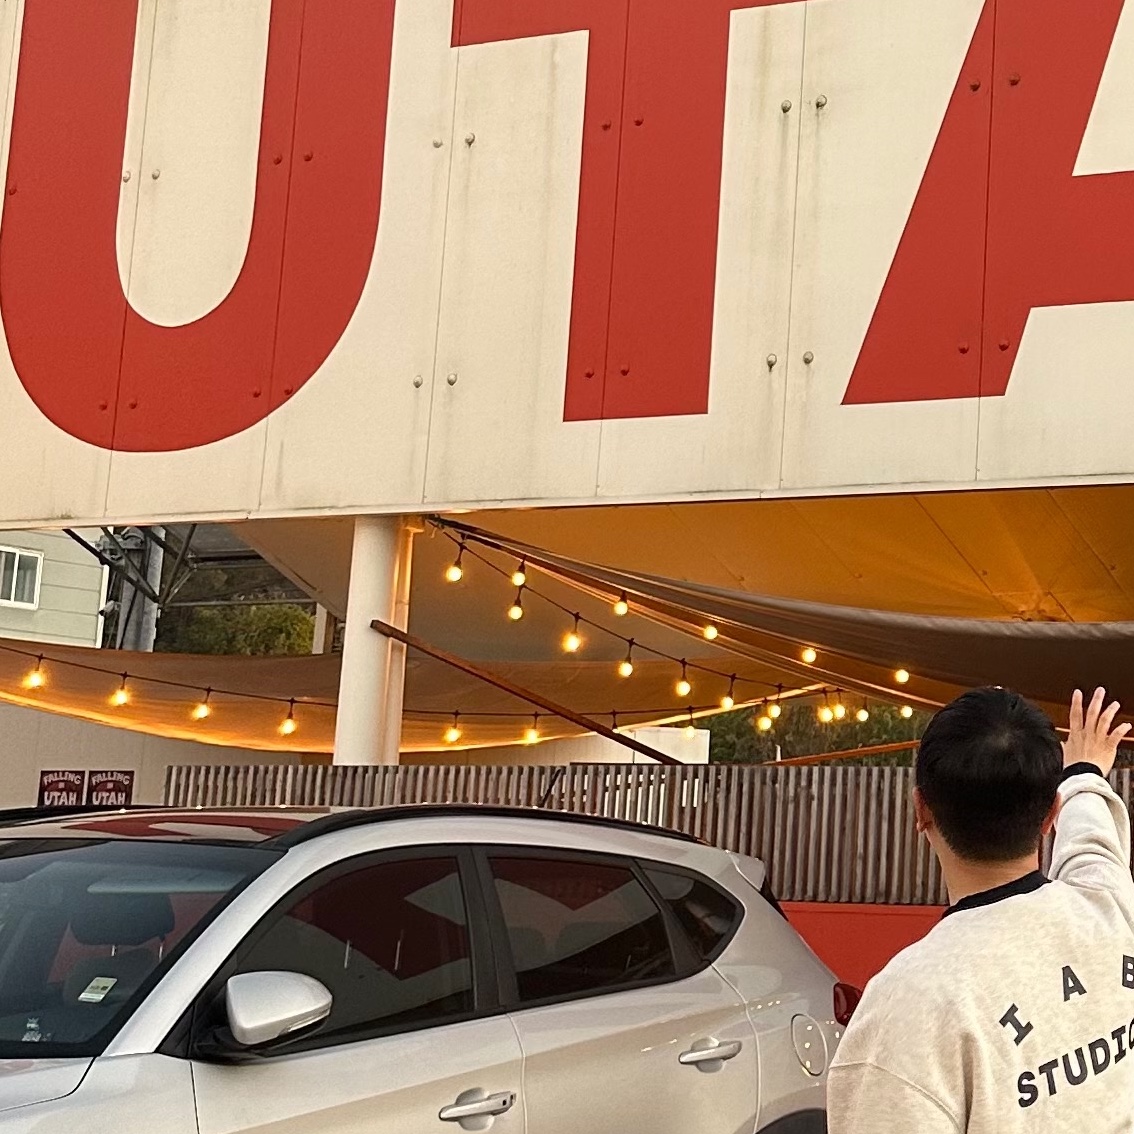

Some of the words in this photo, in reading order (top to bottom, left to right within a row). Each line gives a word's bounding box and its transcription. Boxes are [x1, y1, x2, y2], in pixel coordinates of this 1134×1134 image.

[43, 771, 81, 785] FALLING
[91, 771, 130, 785] FALLING
[44, 791, 77, 806] UTAH
[92, 791, 126, 806] UTAH
